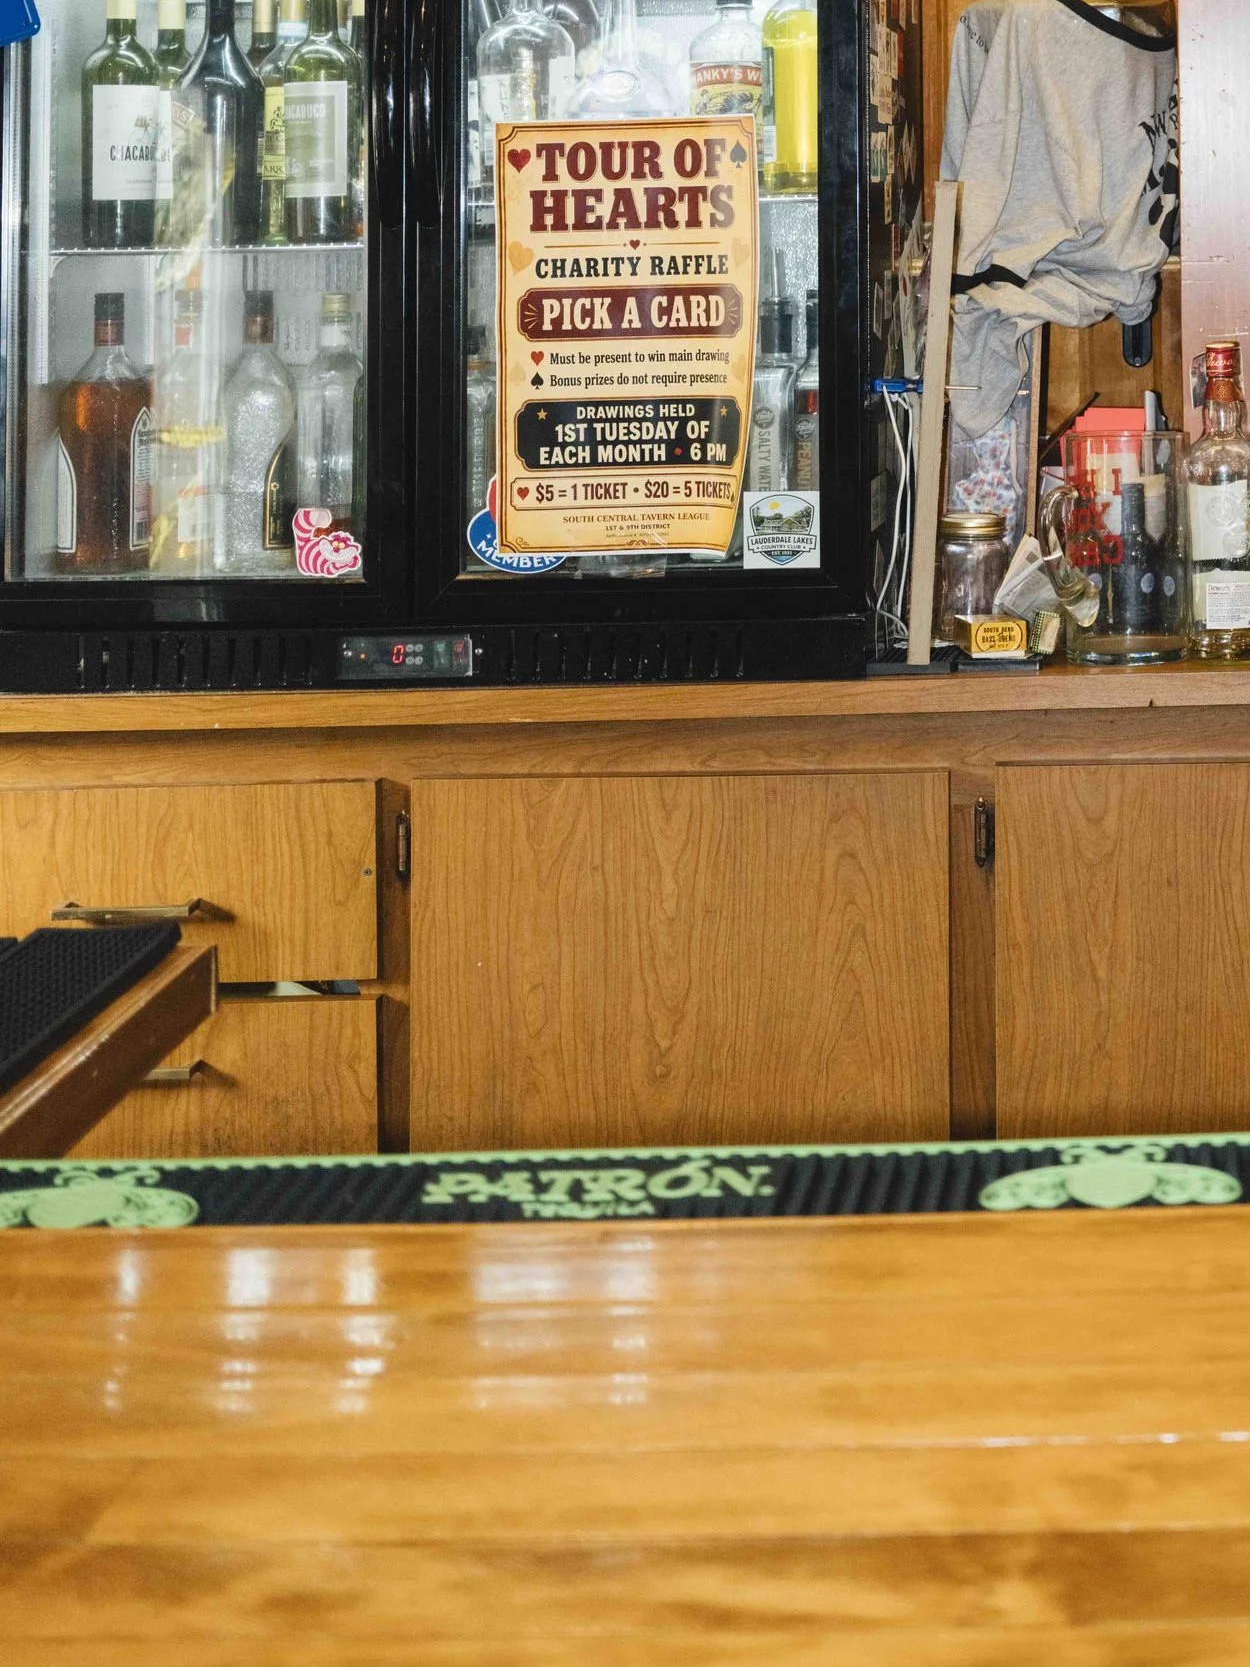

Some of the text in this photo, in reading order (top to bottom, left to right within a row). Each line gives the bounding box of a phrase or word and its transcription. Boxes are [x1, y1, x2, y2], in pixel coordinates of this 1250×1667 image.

[693, 69, 743, 83] ANKY'S
[536, 138, 726, 182] TOUR OF
[529, 184, 735, 232] HEARTS
[535, 254, 729, 279] CHARITY RAFFLE
[541, 294, 726, 331] PICK A CARD
[549, 349, 730, 366] Must be present to win main drawing
[549, 371, 728, 389] Bonus prizes do not require presence
[576, 403, 696, 420] DRAWINGS HELD
[555, 420, 710, 443] 1ST TUESDAY OF
[539, 442, 726, 465] EACH MONTH 6 PM
[758, 430, 771, 462] SALTY
[535, 479, 731, 504] $5 1 TICKET $20 5 TICKETS
[562, 512, 710, 523] SOUTH CENTRAL TAVERN LEAGUE
[751, 536, 813, 545] LAUDERDALE LAKES
[476, 539, 560, 568] MEMBER
[521, 1201, 655, 1219] TEQUILA
